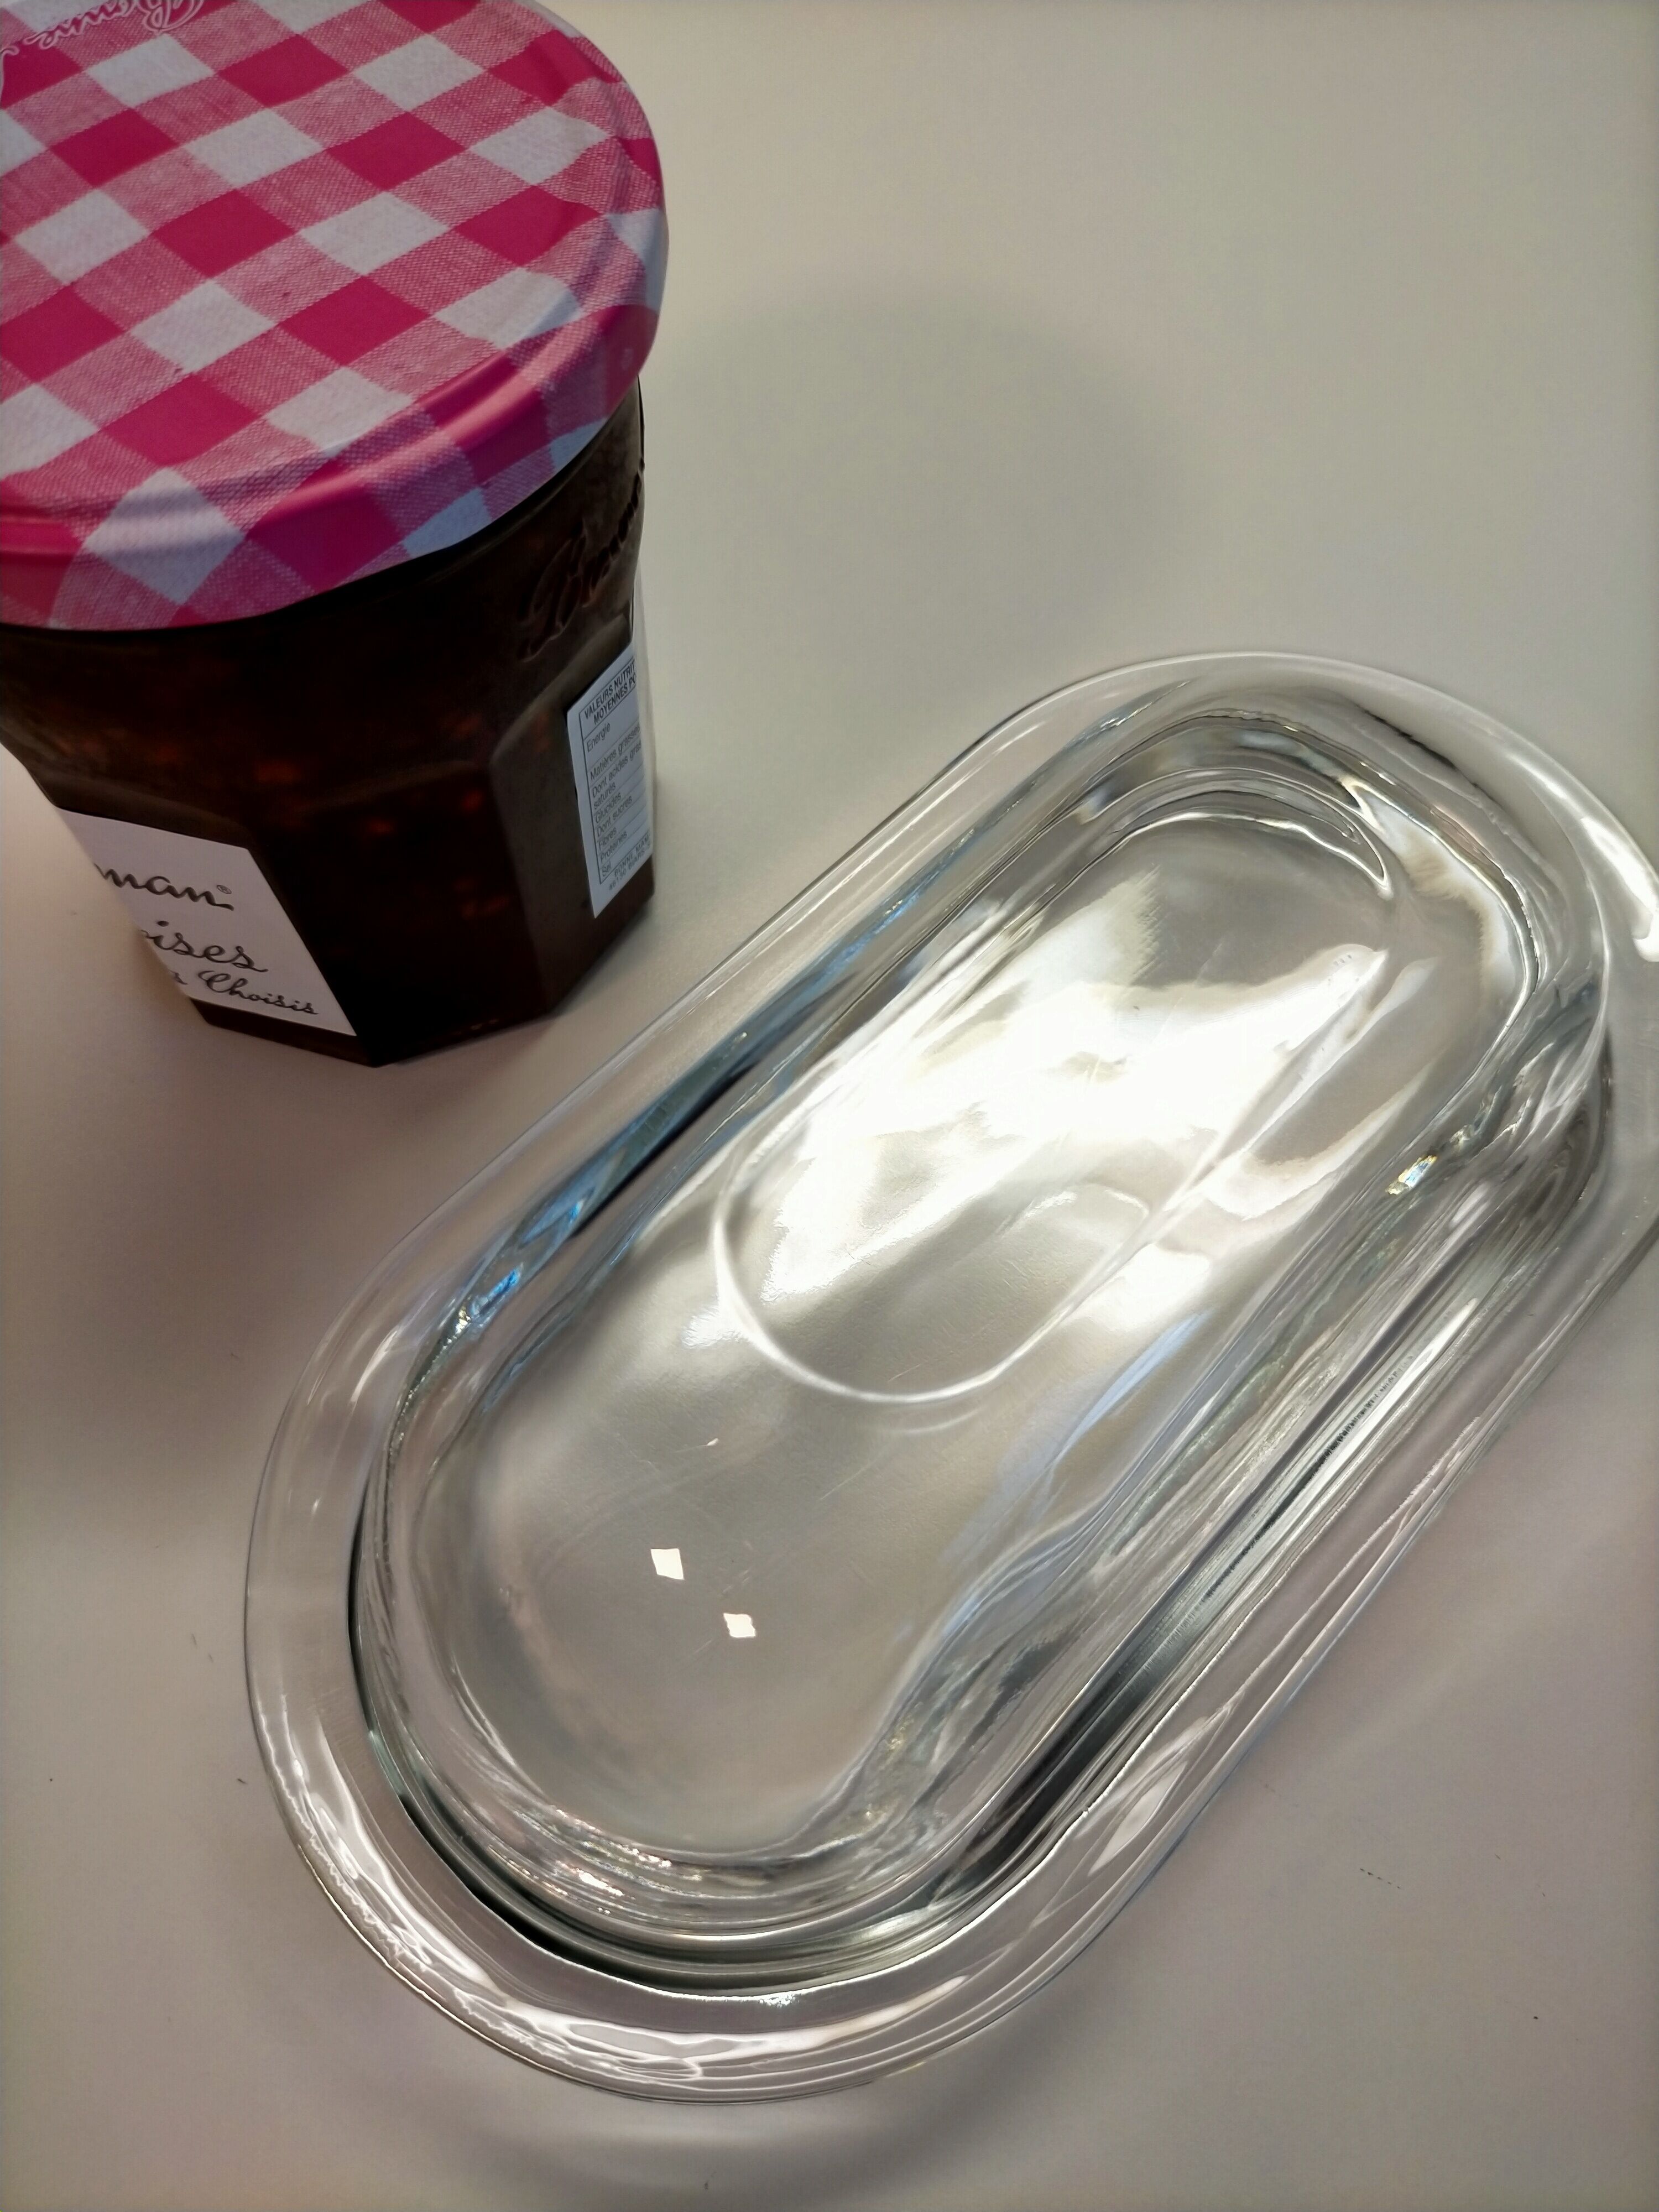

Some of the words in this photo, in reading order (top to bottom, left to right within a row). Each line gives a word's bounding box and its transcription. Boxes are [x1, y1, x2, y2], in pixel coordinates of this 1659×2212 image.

[584, 684, 613, 720] VALEURS
[593, 682, 628, 725] MOYENNES
[587, 722, 611, 753] Energie
[590, 749, 617, 782] Matières
[592, 777, 607, 798] Dont
[609, 755, 628, 782] acides
[596, 792, 622, 824] Glucides
[597, 817, 611, 837] Dont
[613, 795, 632, 821] sucres
[599, 827, 617, 851] Fibres
[602, 862, 612, 878] Sel
[198, 970, 319, 1015] Choisis
